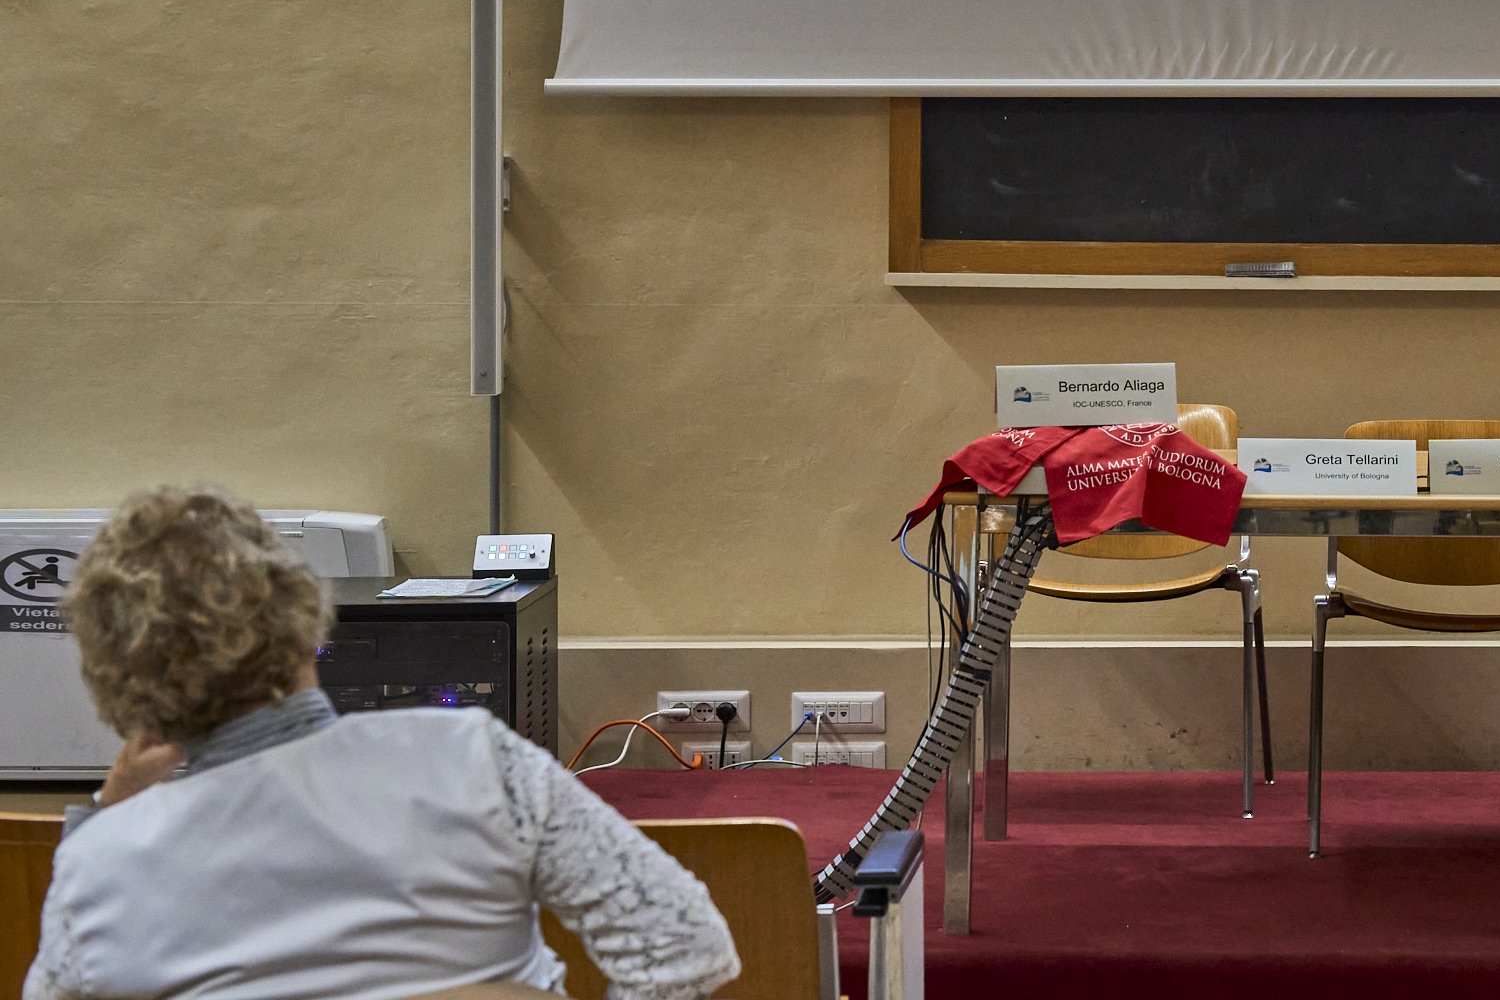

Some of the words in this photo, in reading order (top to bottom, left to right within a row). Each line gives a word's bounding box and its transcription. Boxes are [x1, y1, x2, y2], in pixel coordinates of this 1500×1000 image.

[1058, 380, 1120, 393] Bernardo
[1123, 379, 1165, 394] Aliaga
[1072, 400, 1126, 408] IOC-UNESCO,
[1066, 462, 1105, 477] ALMA
[1150, 444, 1226, 476] STUDIORUM
[1305, 454, 1342, 465] Greta
[1347, 454, 1398, 465] Tellarini
[1157, 462, 1222, 490] BOLOGNA
[1315, 472, 1350, 480] University
[1351, 472, 1359, 480] of
[1360, 472, 1390, 480] Bologna
